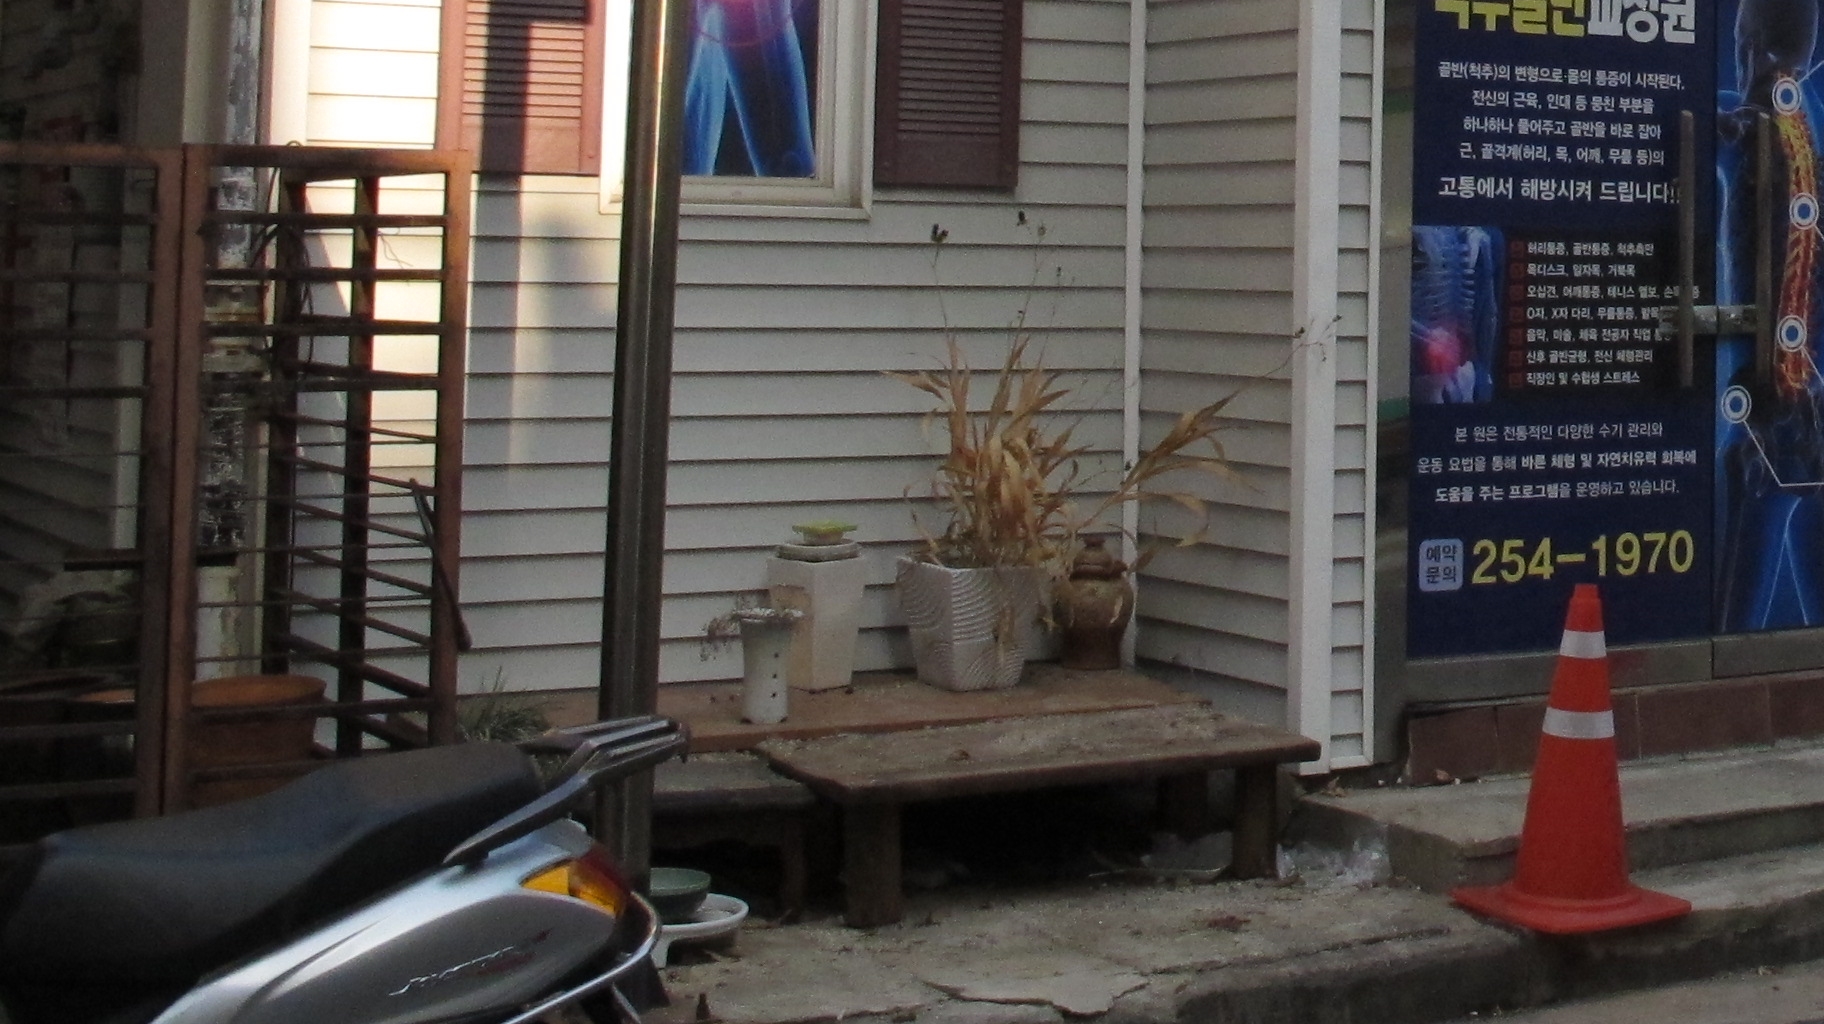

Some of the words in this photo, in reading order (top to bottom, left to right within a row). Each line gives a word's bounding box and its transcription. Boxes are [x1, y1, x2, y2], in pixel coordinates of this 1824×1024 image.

[1438, 61, 1511, 81] 골반(척추)의
[1595, 70, 1631, 87] 통증이
[1635, 73, 1686, 90] 시작된다.
[1472, 89, 1509, 107] 전신의
[1513, 92, 1542, 109] 근육,
[1547, 93, 1571, 110] 인대
[1574, 95, 1588, 111] 등
[1591, 95, 1615, 113] 뭉친
[1619, 97, 1655, 114] 부분을
[1463, 116, 1514, 133] 하나하나
[1517, 118, 1566, 135] 풀어주고
[1570, 121, 1606, 138] 골반을
[1610, 123, 1634, 138] 바로
[1638, 123, 1662, 140] 잡아
[1576, 147, 1604, 164] 어깨,
[1608, 149, 1632, 165] 무릎
[1636, 149, 1665, 166] 등)의
[1438, 176, 1513, 199] 고통에서
[1520, 178, 1592, 201] 해방시켜
[1454, 426, 1468, 442] 본
[1473, 426, 1498, 442] 원은
[1503, 425, 1553, 442] 전통적인
[1557, 424, 1594, 441] 다양한
[1599, 423, 1623, 438] 수기
[1627, 422, 1663, 438] 관리와
[1417, 457, 1443, 474] 운동
[1448, 456, 1486, 473] 요법을
[1492, 455, 1517, 471] 통해
[1521, 454, 1546, 471] 바른
[1551, 452, 1576, 469] 체형
[1580, 452, 1593, 468] 및
[1597, 451, 1657, 468] 자연치유력
[1661, 449, 1697, 466] 회복에
[1435, 485, 1474, 503] 도움을
[1479, 484, 1504, 501] 주는
[1508, 482, 1571, 499] 프로그램을
[1576, 481, 1624, 497] 운영하고
[1629, 479, 1680, 495] 있습니다.
[1426, 545, 1458, 563] 예약
[1471, 529, 1694, 584] 254-1970
[1426, 565, 1457, 584] 문의
